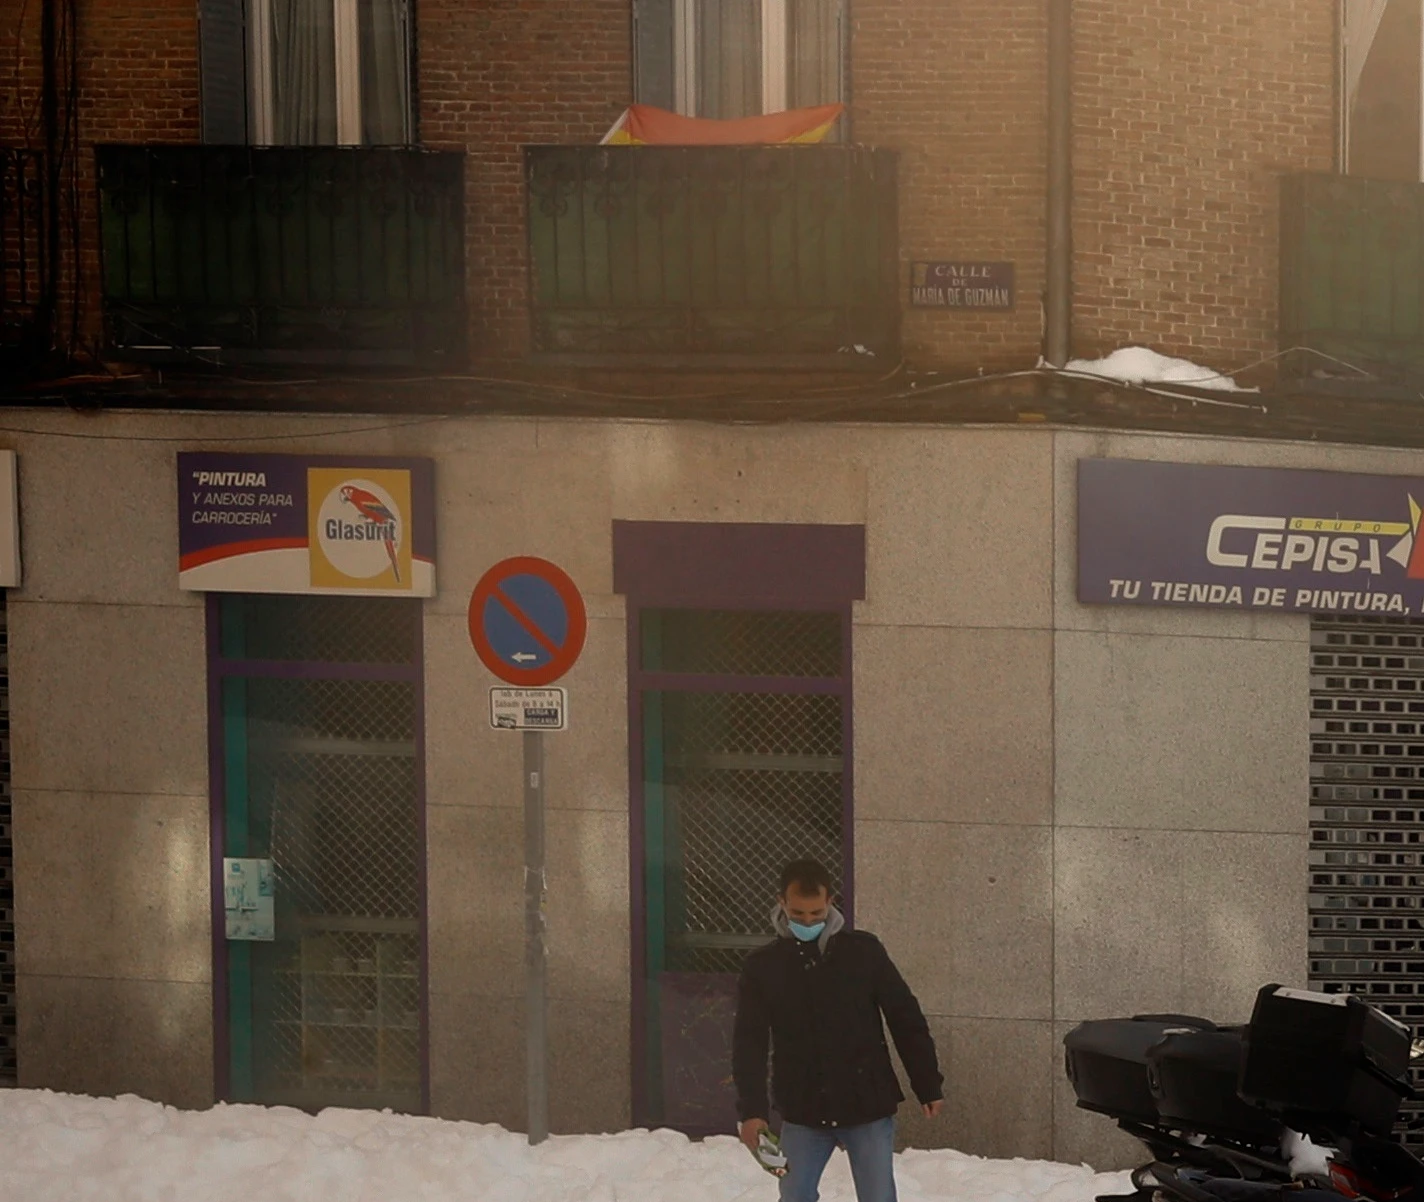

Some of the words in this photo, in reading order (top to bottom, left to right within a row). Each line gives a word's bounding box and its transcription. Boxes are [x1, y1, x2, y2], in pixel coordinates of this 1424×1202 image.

[935, 265, 991, 278] CALLE
[952, 279, 967, 287] DE
[948, 288, 961, 306] DE
[192, 492, 201, 505] Y
[204, 493, 256, 506] ANEXOS
[259, 494, 293, 507] PARA
[326, 518, 396, 542] Glasurit
[1206, 514, 1382, 575] CEPISA
[1109, 579, 1141, 599] TU
[1151, 581, 1243, 605] TIENDA
[1252, 587, 1287, 607] DE
[1295, 588, 1409, 615] PINTURA,
